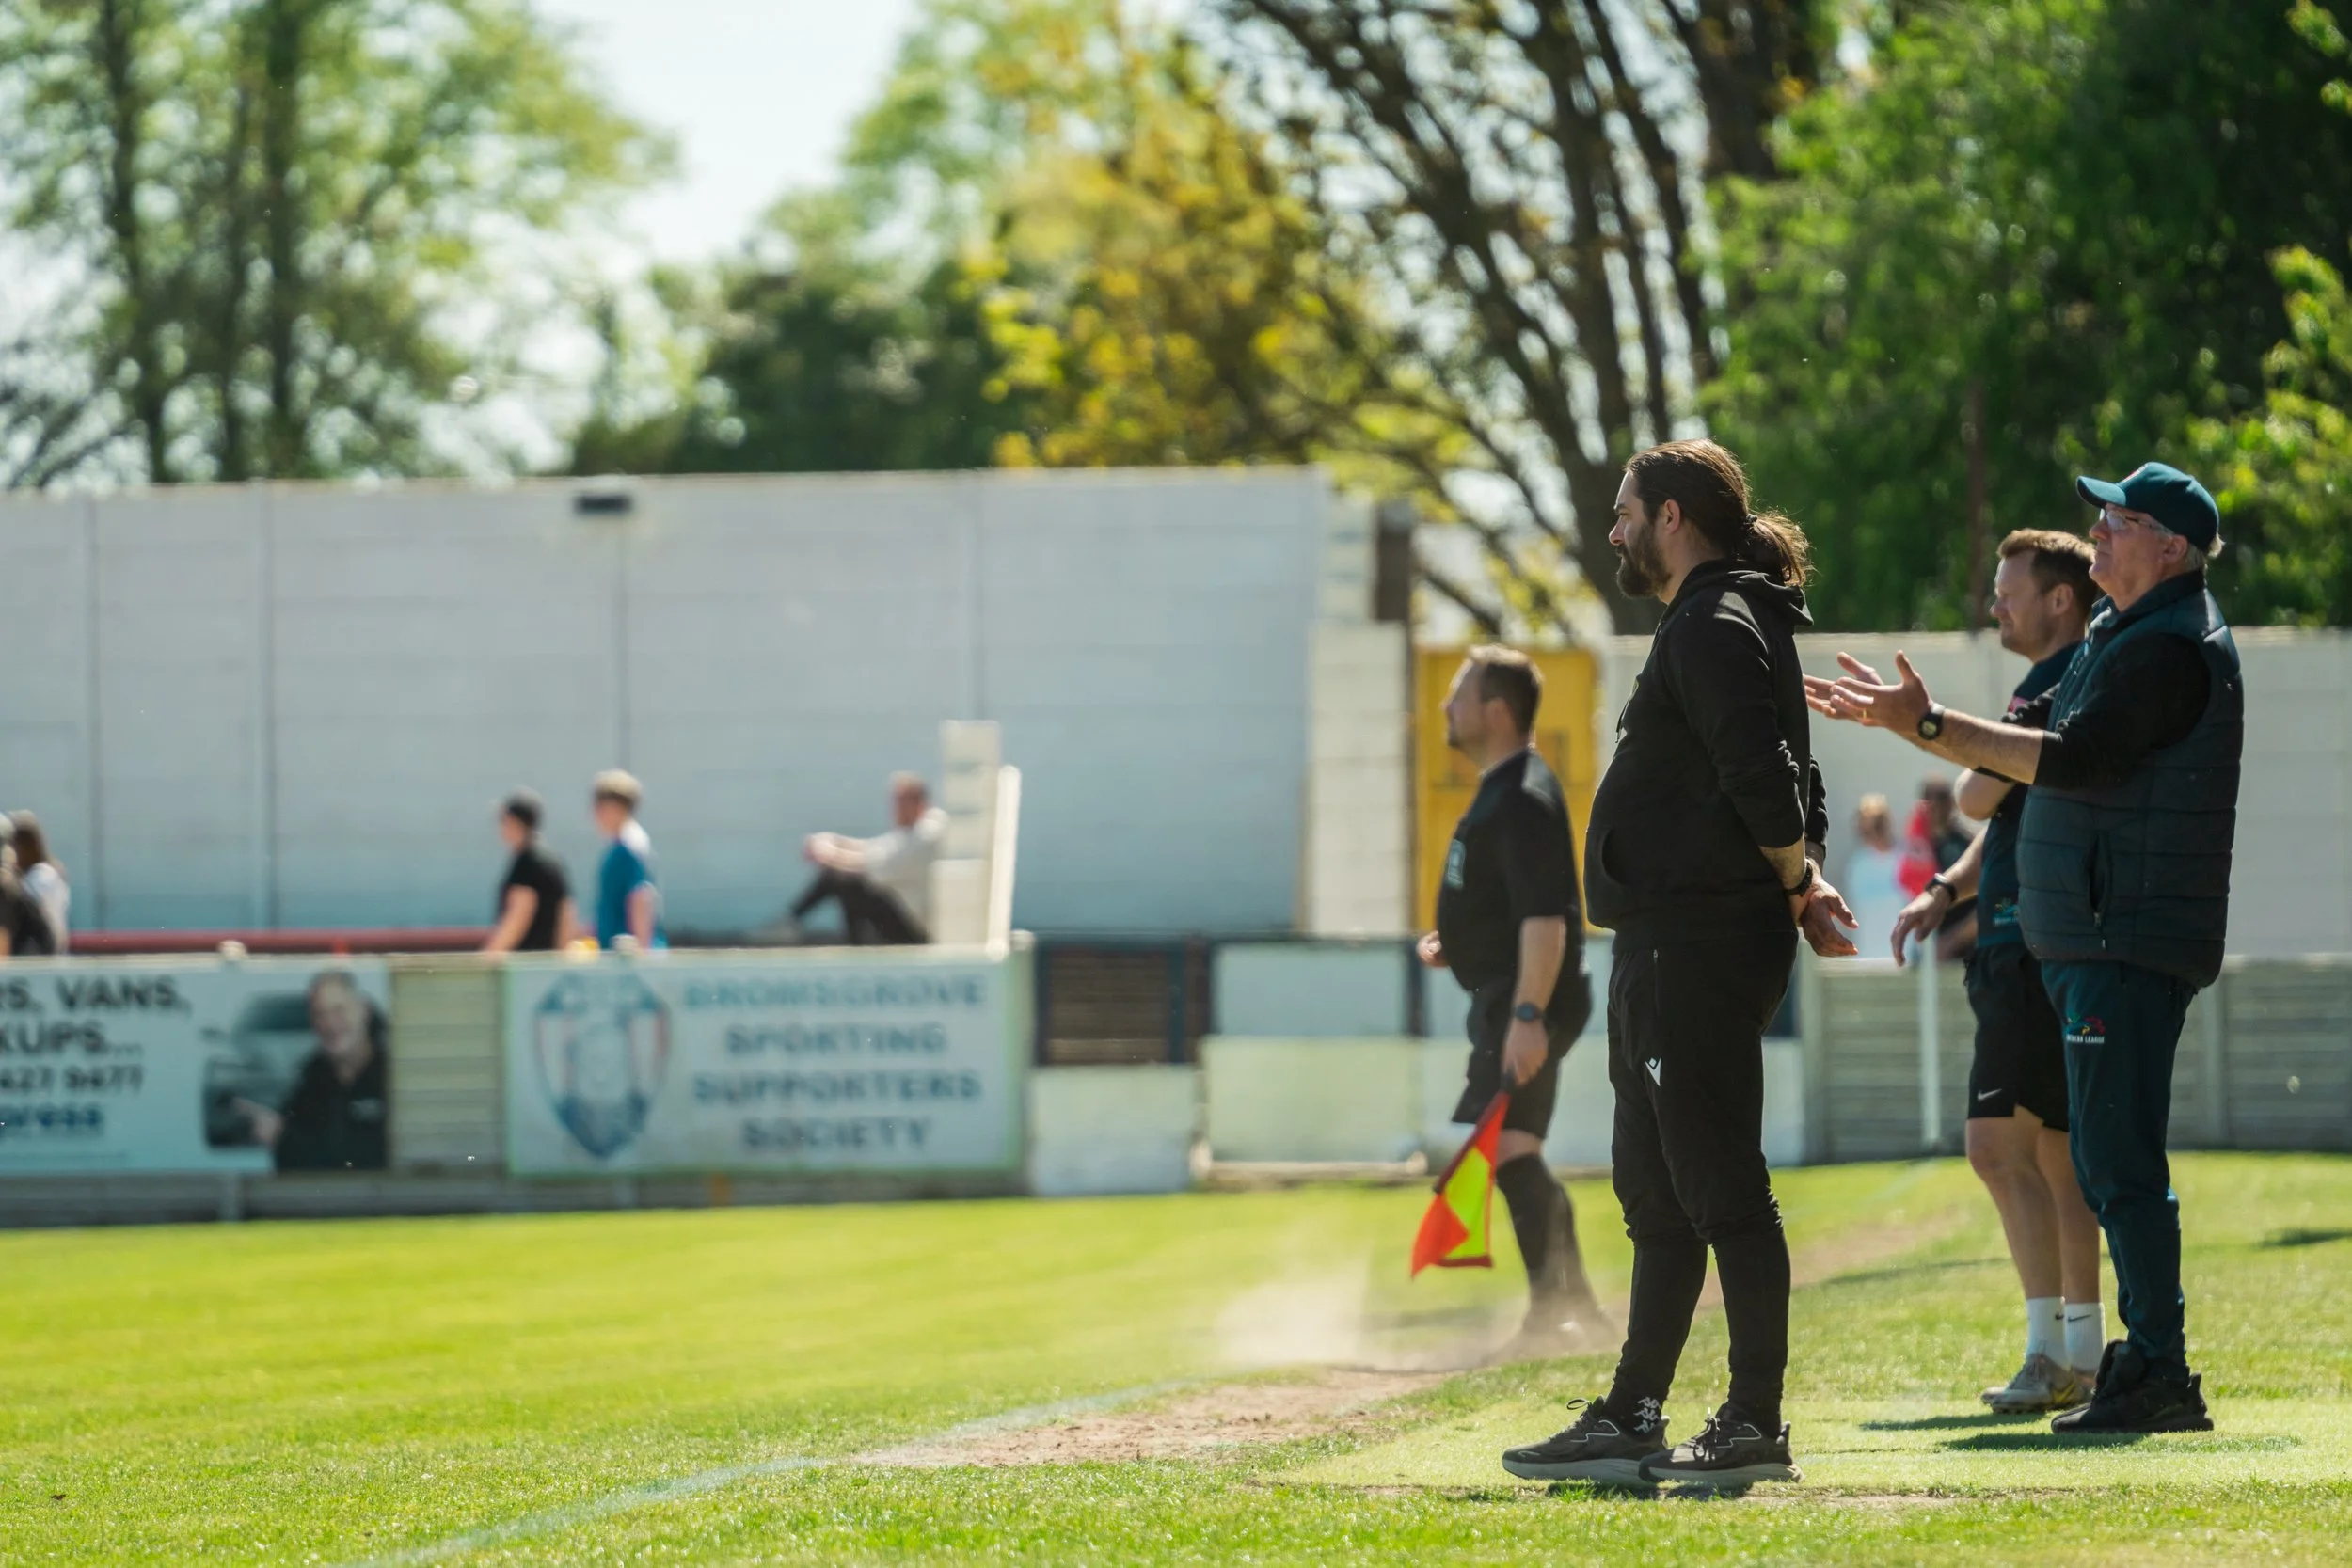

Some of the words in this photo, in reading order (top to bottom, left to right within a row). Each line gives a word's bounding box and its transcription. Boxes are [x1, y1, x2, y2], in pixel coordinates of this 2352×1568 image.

[55, 975, 192, 1015] VANS,
[685, 974, 988, 1009] BROMSGROVE
[725, 1022, 947, 1054] SPORTING
[693, 1069, 983, 1102] SUPPORTERS
[742, 1117, 931, 1150] SOCIETY
